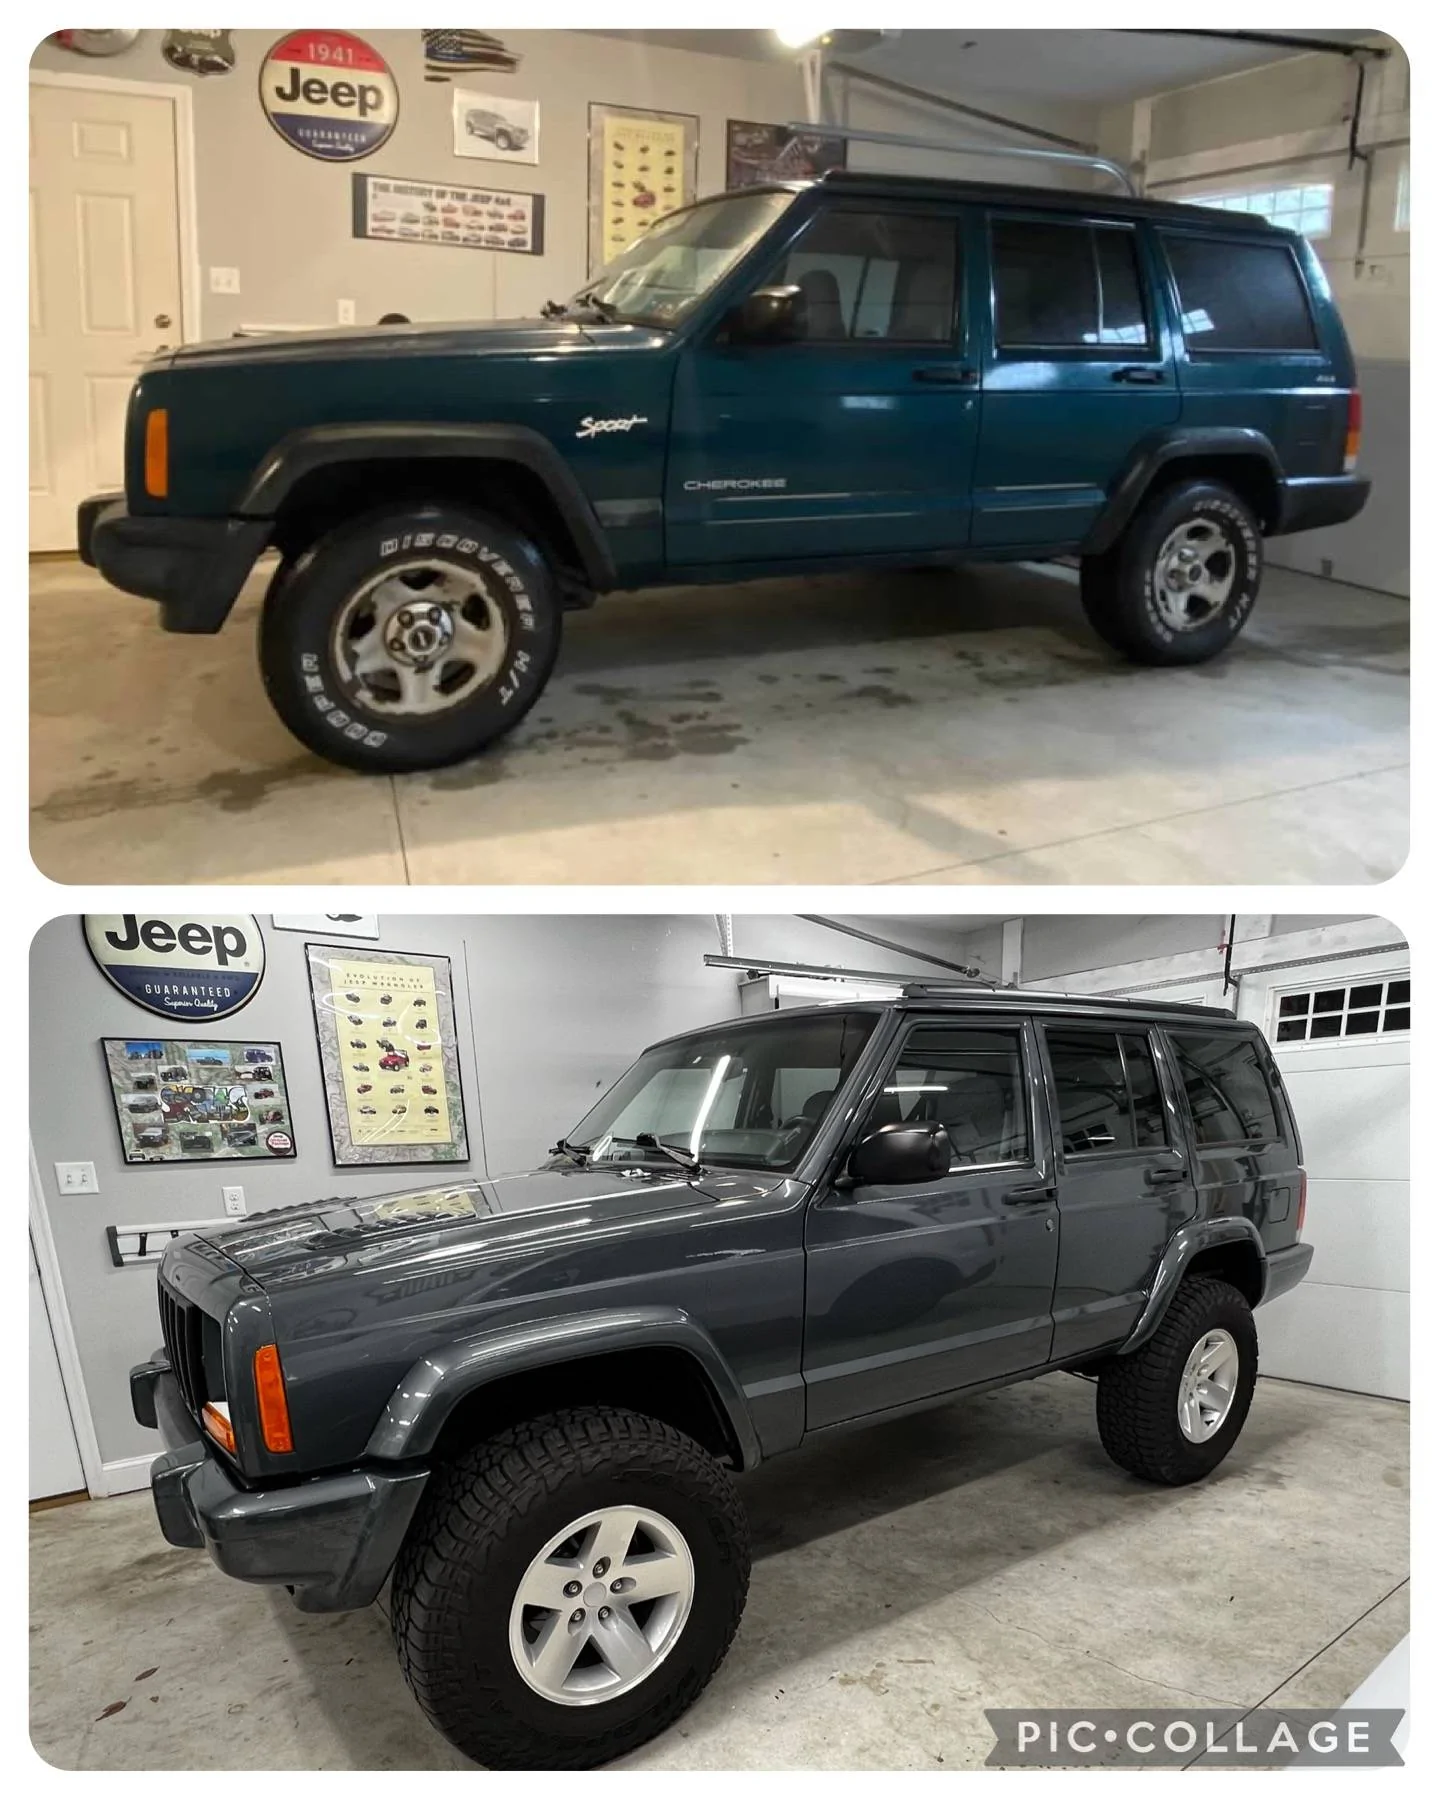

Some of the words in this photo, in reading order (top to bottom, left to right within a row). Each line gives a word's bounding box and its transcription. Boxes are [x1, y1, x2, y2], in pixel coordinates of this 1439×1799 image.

[308, 42, 353, 65] 1941
[275, 66, 384, 118] Jeep
[575, 414, 648, 439] Sport
[683, 478, 788, 491] CHEROKEE
[380, 532, 535, 630] DISCOVERER
[301, 653, 388, 748] COOPER
[105, 914, 247, 966] Jeep
[145, 983, 231, 998] GUARANTEED
[164, 997, 193, 1010] Superior
[194, 998, 218, 1012] Quality
